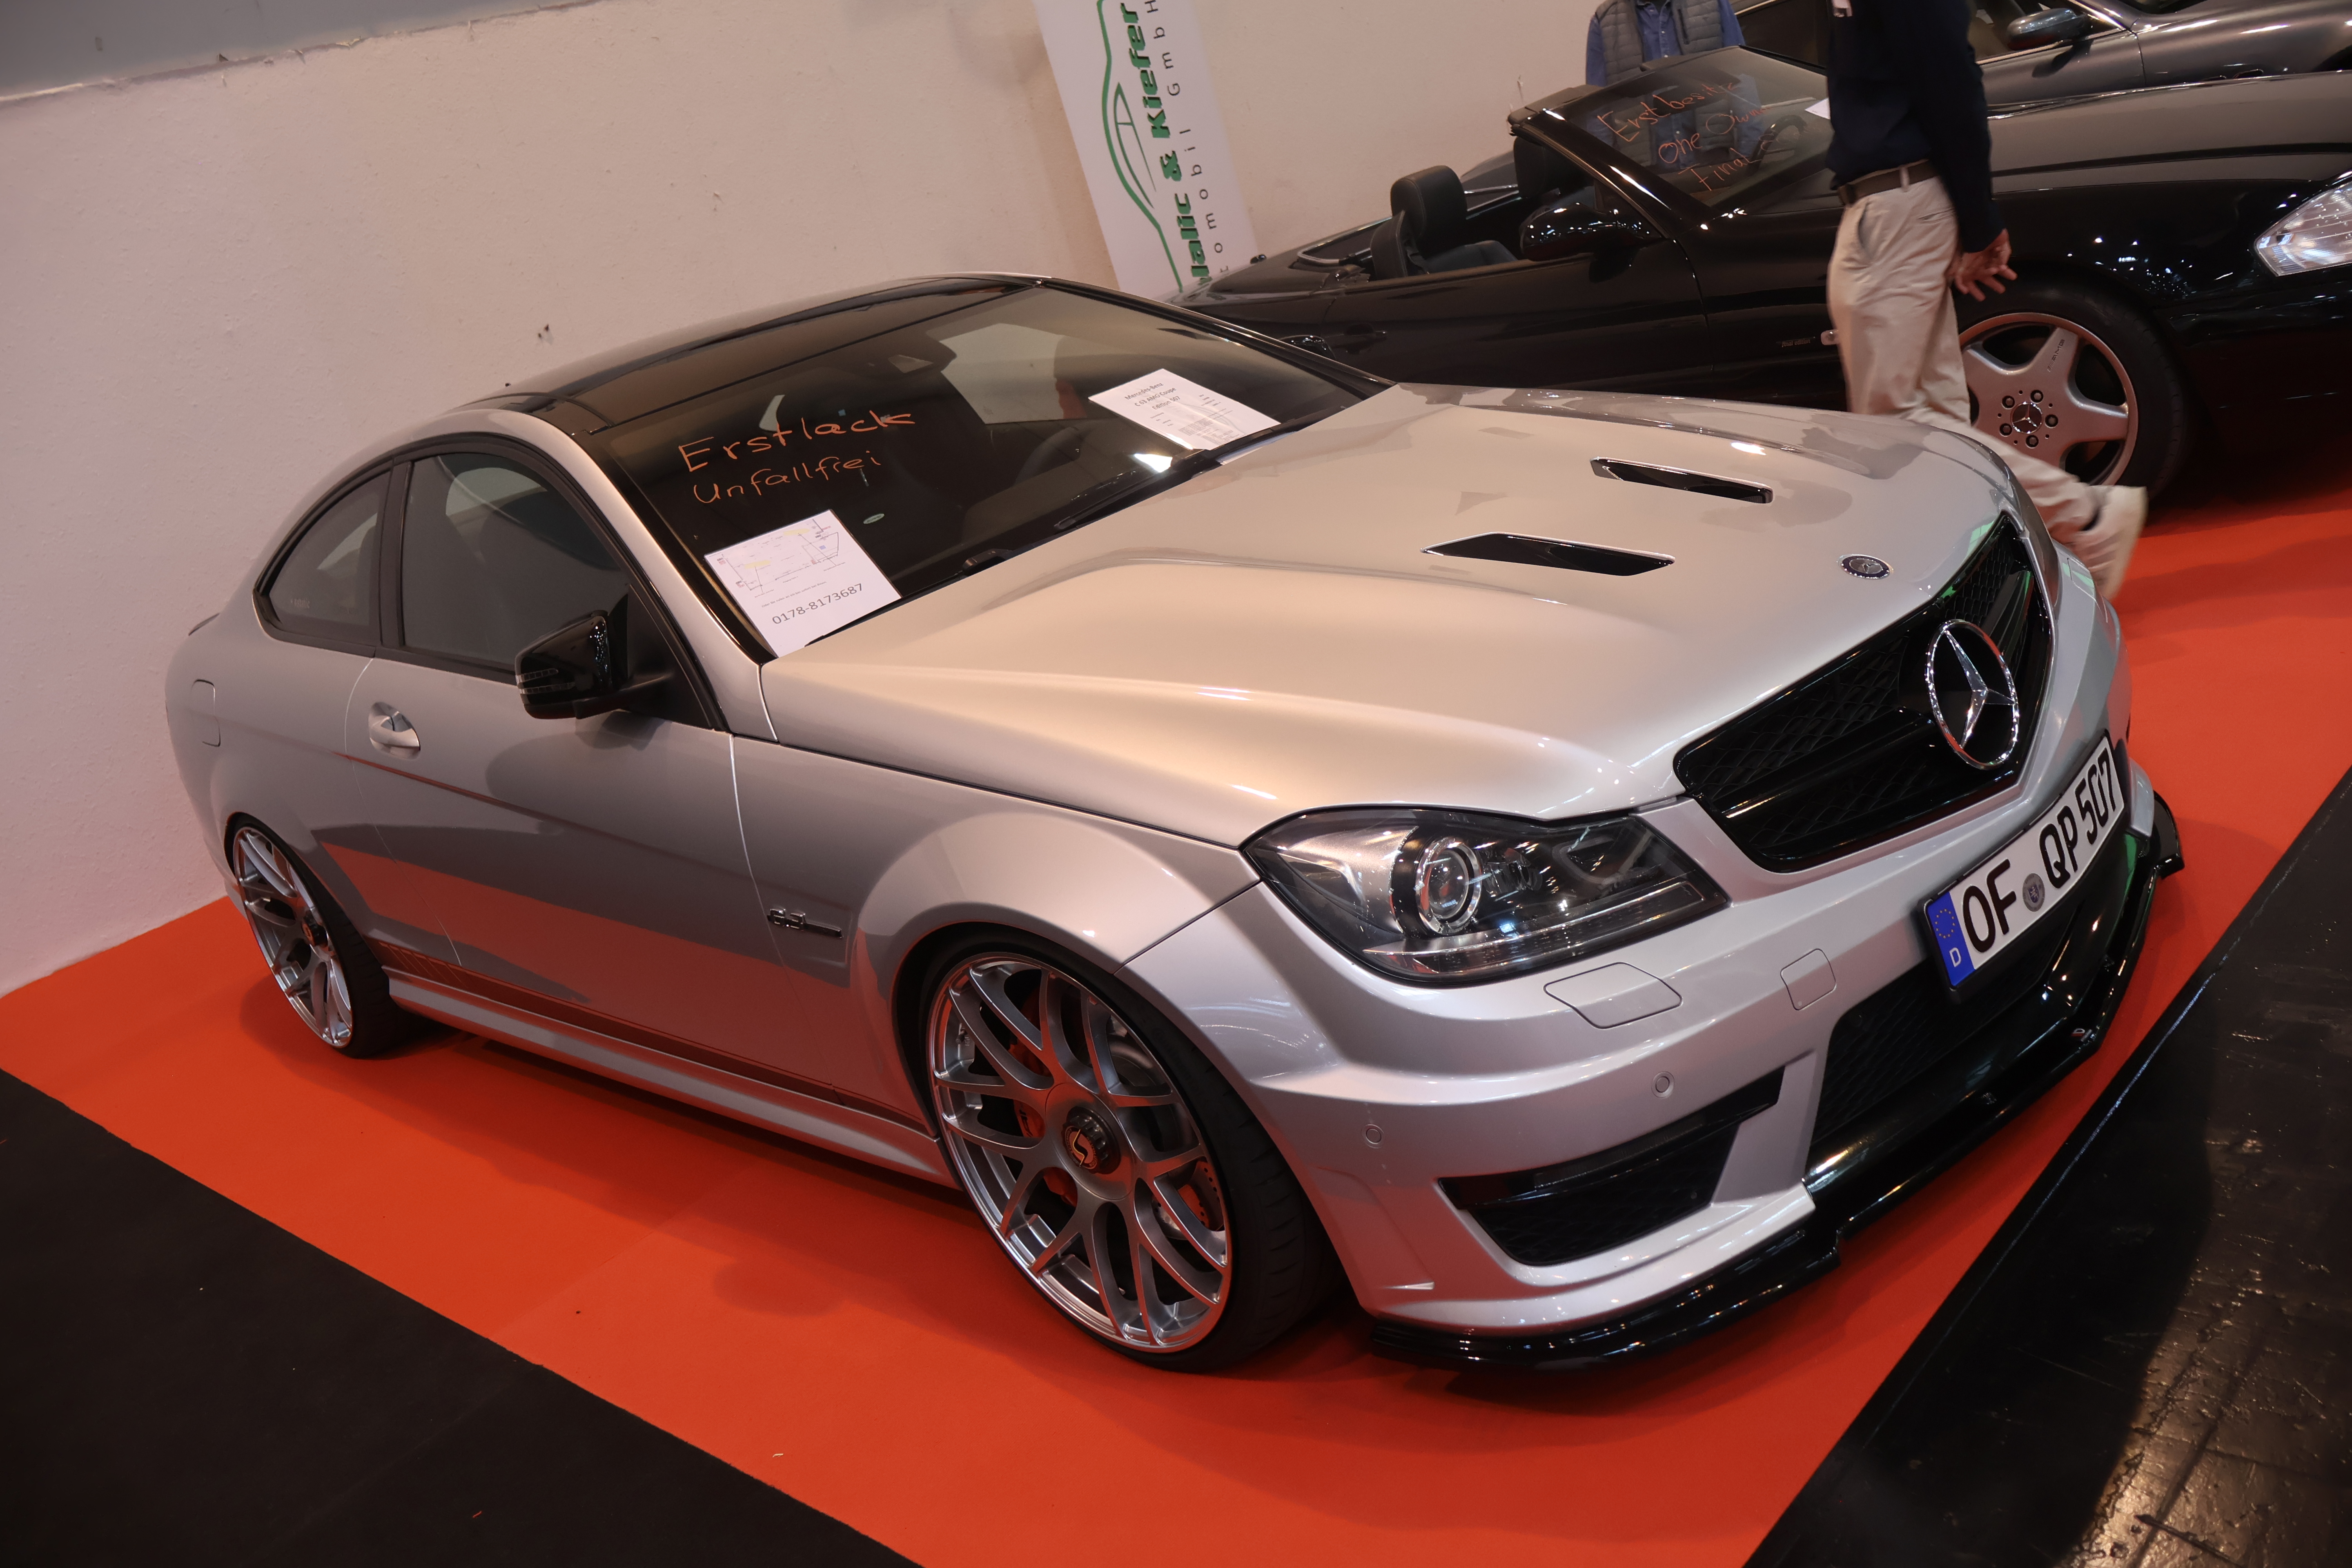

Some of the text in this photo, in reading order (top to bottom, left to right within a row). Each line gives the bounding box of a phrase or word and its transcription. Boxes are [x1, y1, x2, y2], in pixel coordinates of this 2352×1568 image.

[1120, 2, 1171, 138] Kiefer
[1144, 0, 1181, 96] GmbH
[1160, 150, 1181, 182] &
[1125, 383, 1164, 400] Mercedes-Benz
[1152, 400, 1172, 410] Edition
[1160, 387, 1176, 396] Coupe
[679, 410, 915, 472] Erstlack
[694, 450, 881, 503] Unfallfrei
[772, 583, 862, 624] 0178-8173687
[1949, 747, 2116, 967] D OF QP 507
